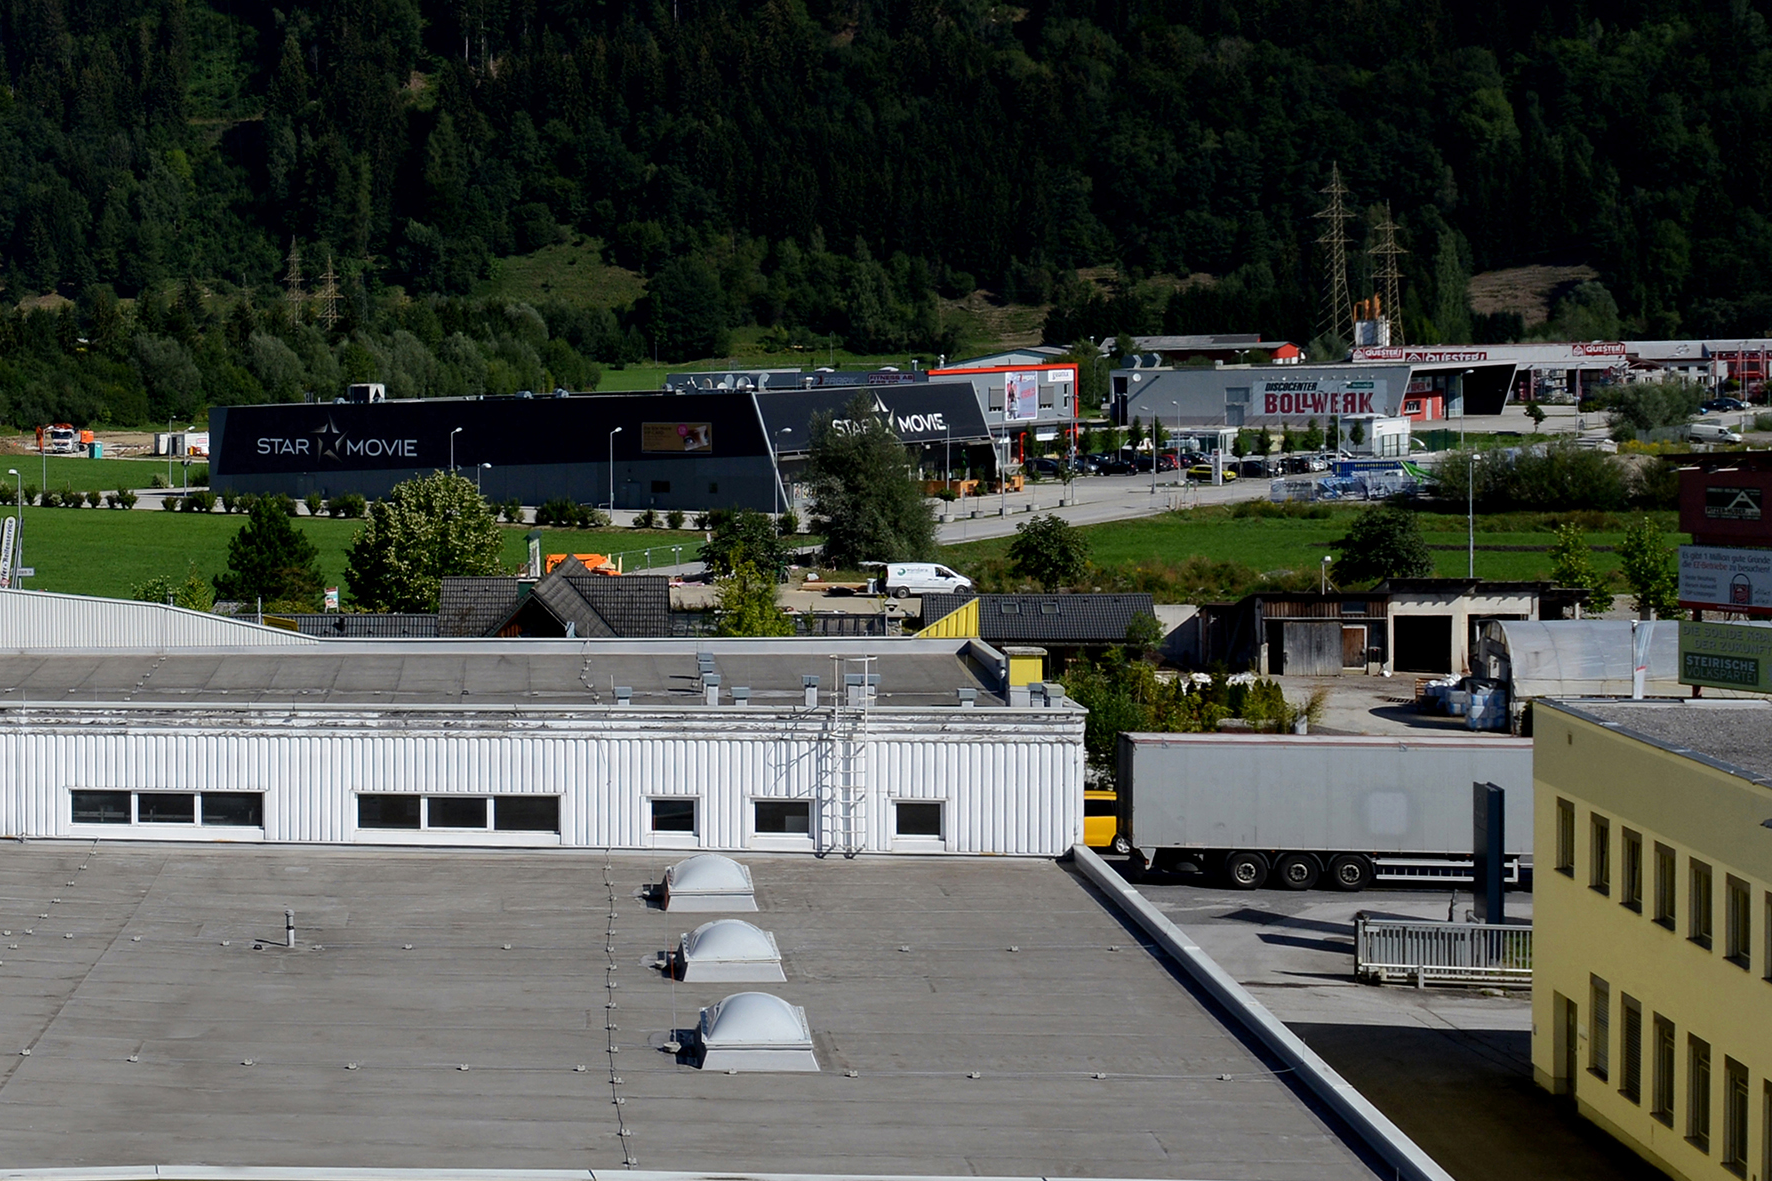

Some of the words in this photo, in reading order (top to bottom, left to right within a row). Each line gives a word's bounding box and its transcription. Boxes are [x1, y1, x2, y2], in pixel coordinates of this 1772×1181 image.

[1265, 382, 1317, 391] DISCOCENTER
[897, 413, 946, 433] MOVIE
[257, 438, 309, 454] STAR
[347, 439, 418, 457] MOVIE
[1683, 625, 1700, 636] DIE
[1704, 627, 1744, 640] SOLIDE
[1694, 639, 1716, 649] DER
[1720, 642, 1772, 655] ZUKUNFT
[1686, 655, 1756, 672] STEIRISCHE
[1686, 666, 1758, 683] VOLKSPARTEI
